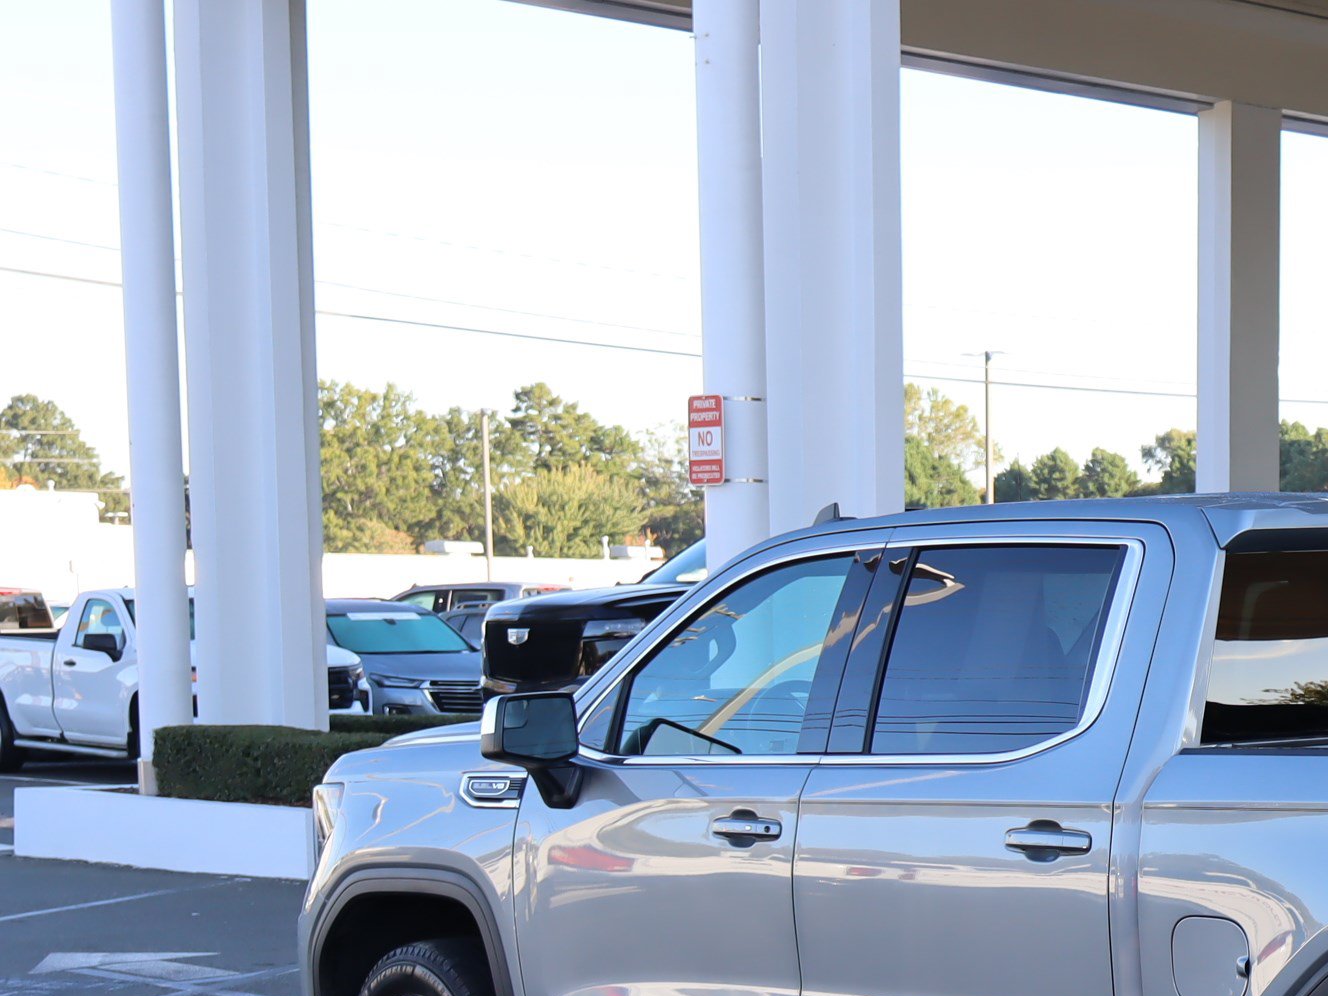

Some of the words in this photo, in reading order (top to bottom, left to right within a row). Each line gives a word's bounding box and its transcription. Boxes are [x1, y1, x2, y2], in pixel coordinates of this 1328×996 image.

[693, 400, 715, 408] PRIVATE
[690, 412, 719, 421] PROPERTY
[697, 431, 713, 446] NO
